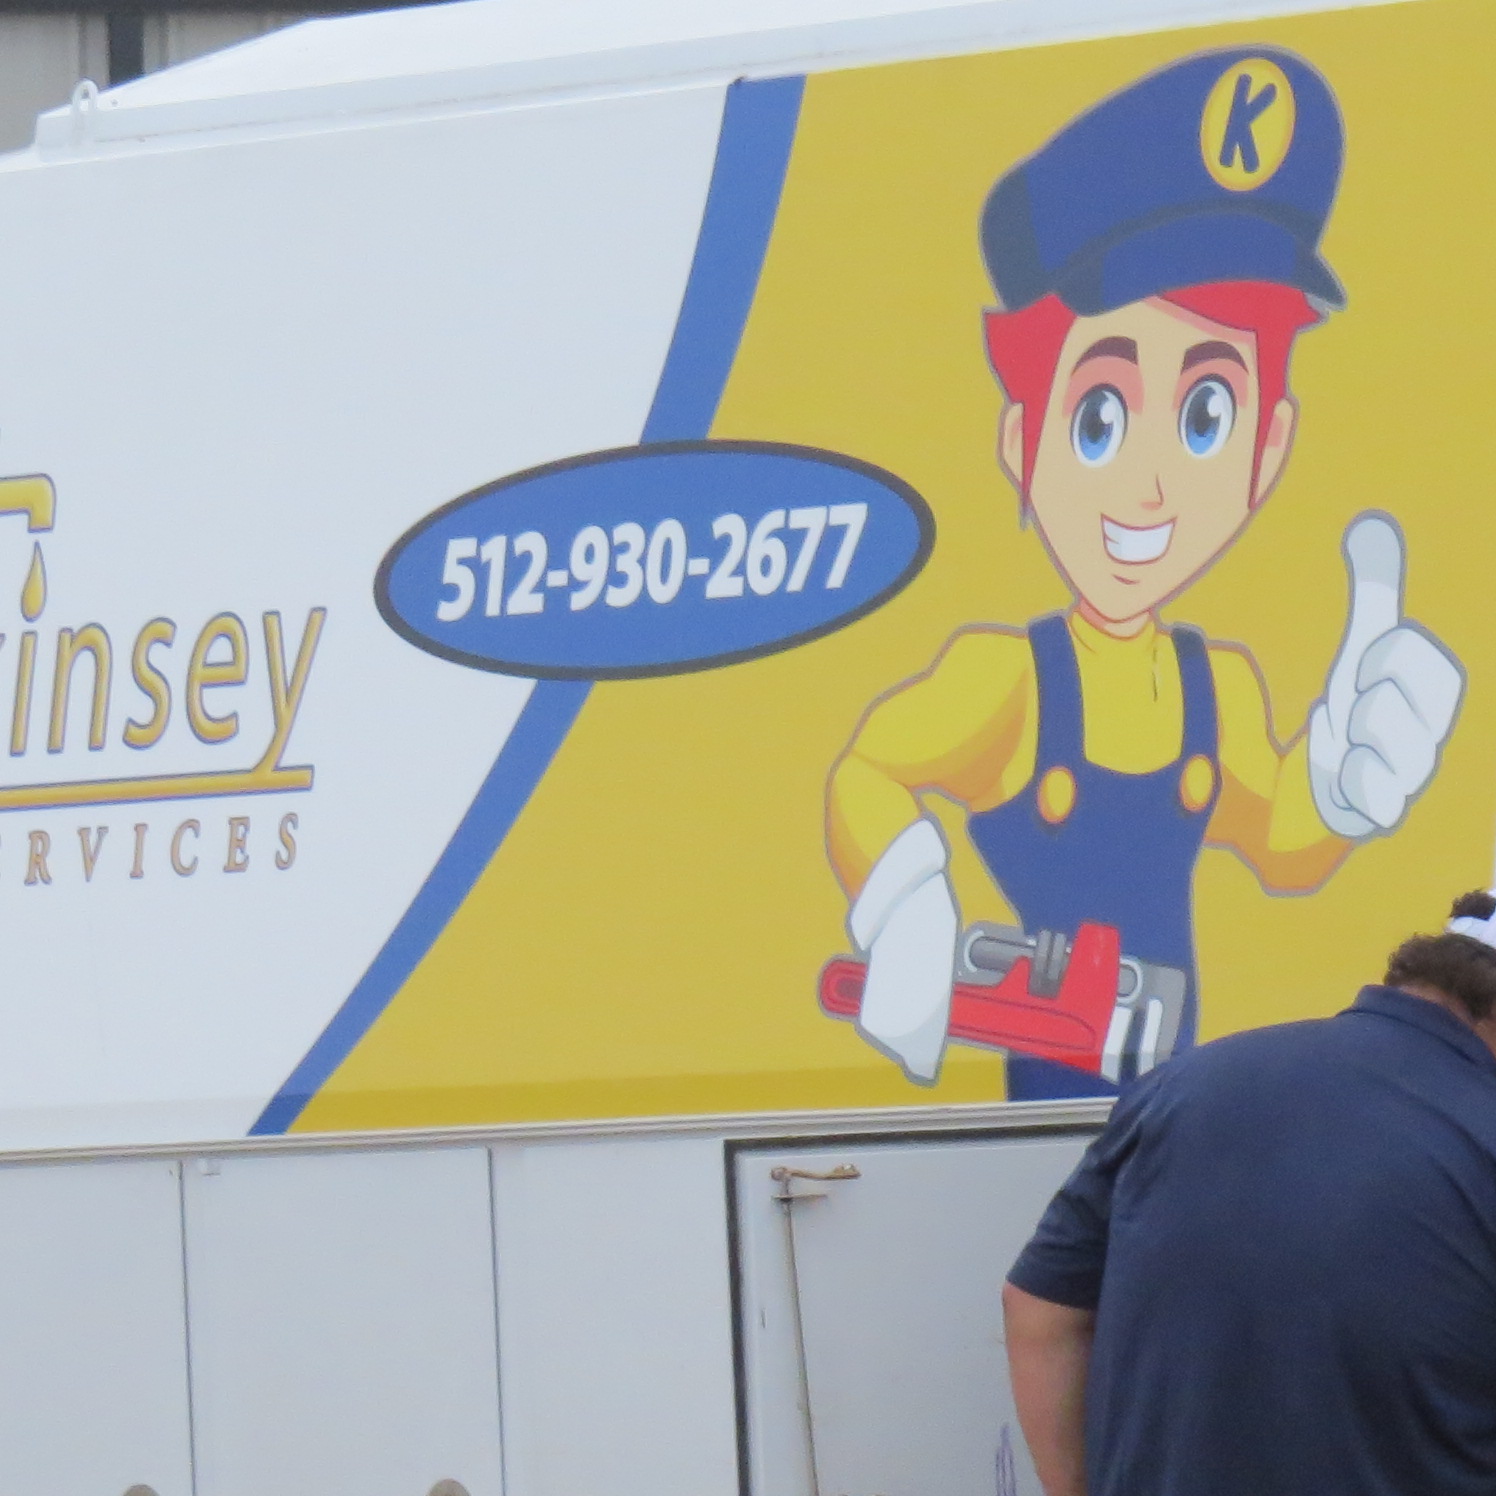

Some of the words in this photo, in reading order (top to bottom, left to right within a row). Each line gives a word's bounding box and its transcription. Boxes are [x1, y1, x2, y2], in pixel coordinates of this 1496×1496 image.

[1219, 73, 1277, 174] K
[436, 502, 868, 622] 512-930-2677
[0, 606, 327, 772] insey
[0, 812, 299, 886] RVICES
